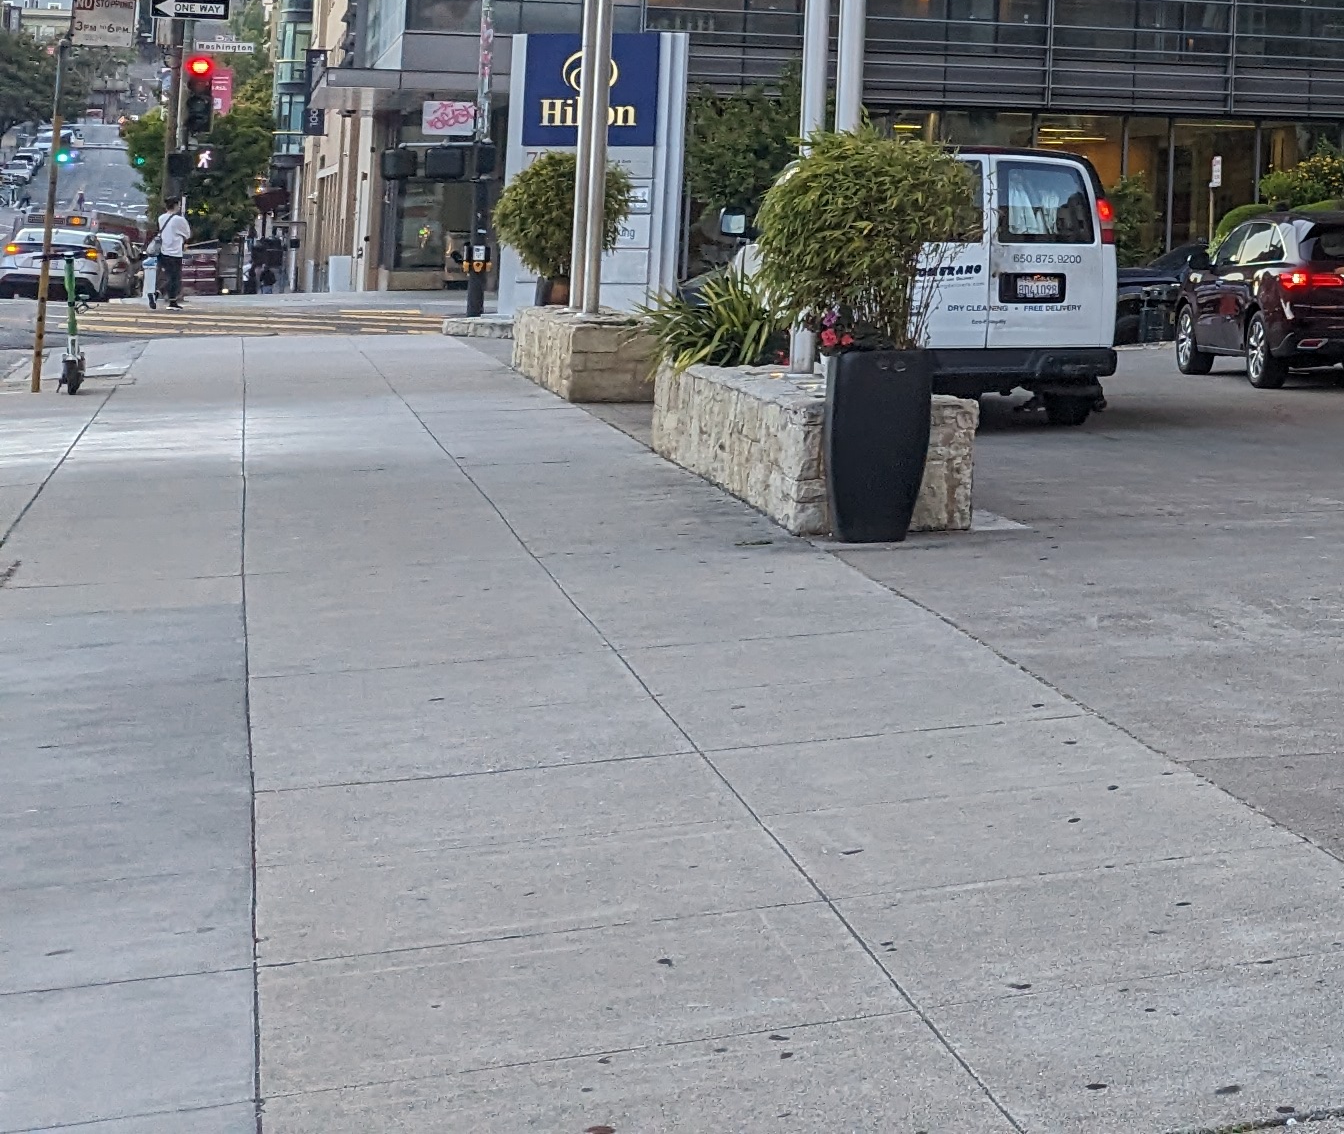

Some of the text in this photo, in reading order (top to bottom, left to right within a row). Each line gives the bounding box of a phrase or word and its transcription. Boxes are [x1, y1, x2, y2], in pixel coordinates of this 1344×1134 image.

[96, 0, 133, 9] STOPPING
[174, 3, 221, 14] ONE WAY
[197, 43, 253, 53] Washington
[1013, 254, 1082, 264] 650.875.9200
[947, 304, 1082, 312] DRY CLEANING FREE DELIVERY
